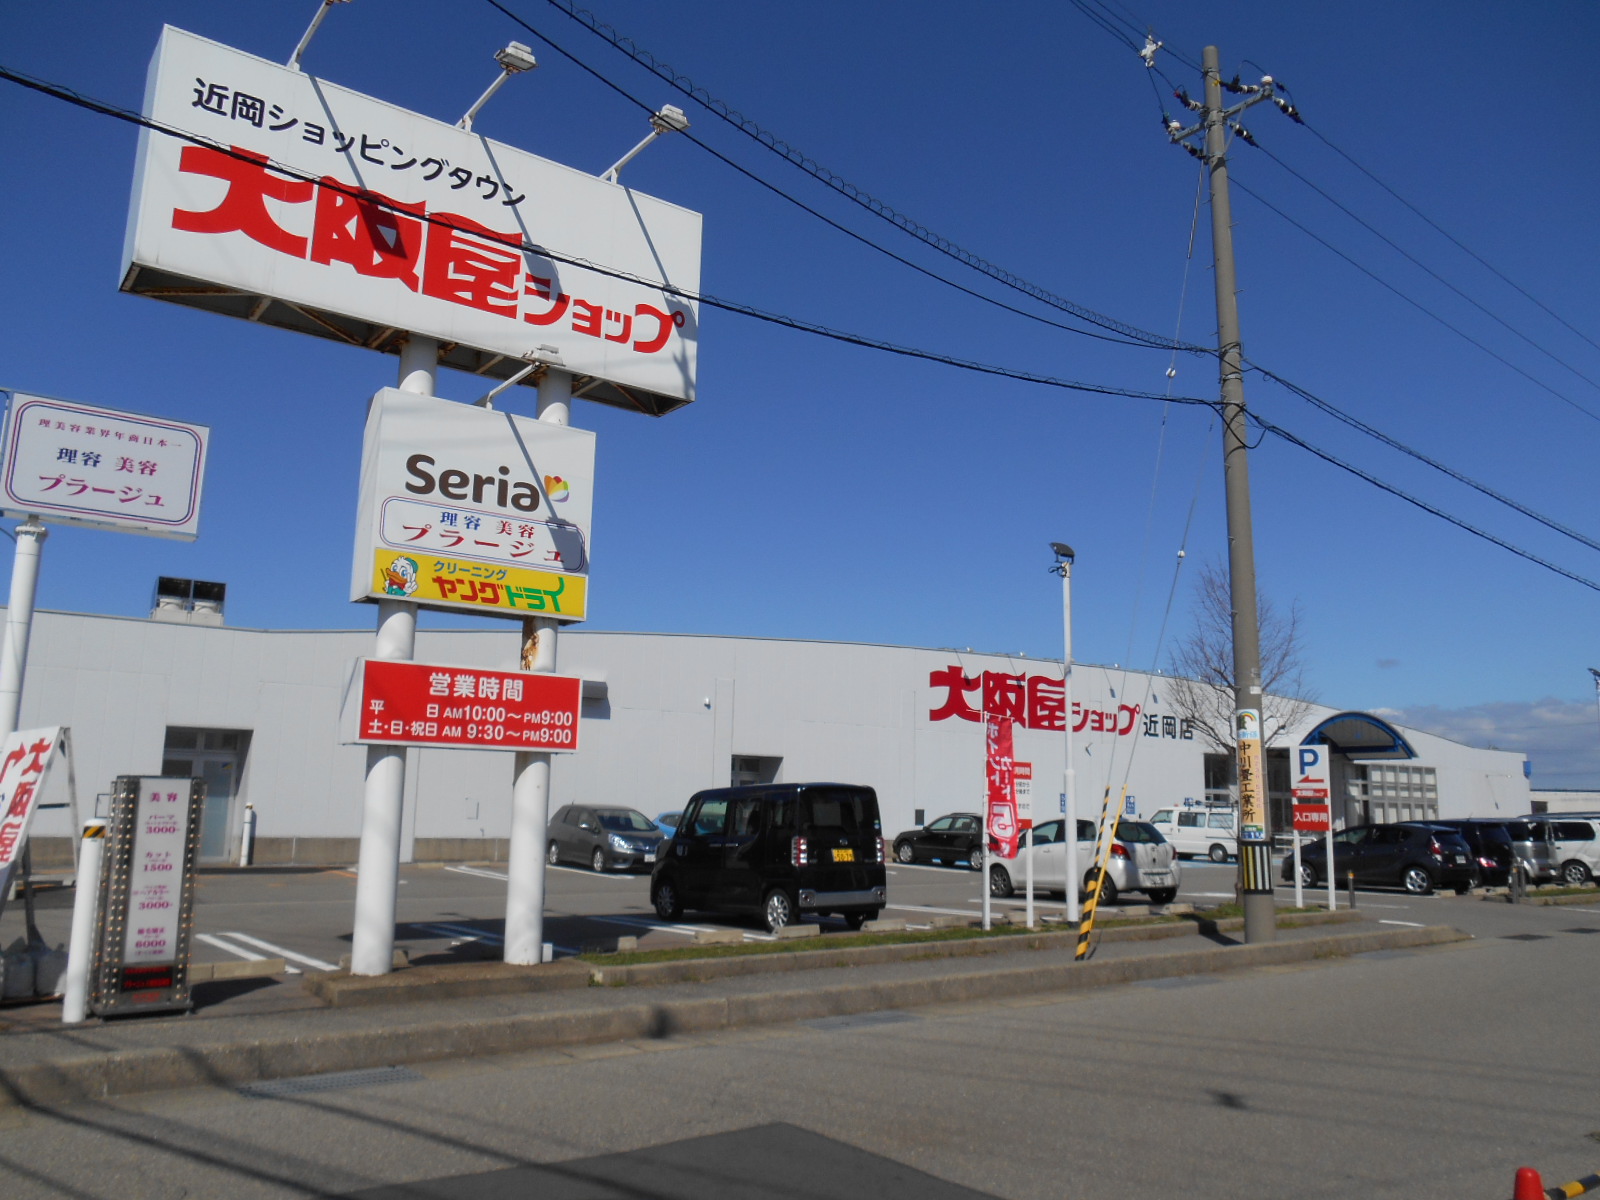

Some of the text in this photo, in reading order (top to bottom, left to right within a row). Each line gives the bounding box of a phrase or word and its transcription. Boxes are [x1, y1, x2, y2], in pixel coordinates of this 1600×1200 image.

[192, 77, 526, 206] 近岡ショッピングタウン
[171, 144, 686, 354] 大阪屋ショップ
[57, 447, 158, 476] 理容 美容
[39, 474, 164, 507] プラージュ
[405, 454, 540, 512] Seria
[440, 511, 535, 539] 理容 美容
[402, 523, 565, 563] プラージュ
[434, 560, 508, 580] クリーニング
[432, 576, 565, 612] ヤングドライ
[429, 673, 523, 701] 営業時間
[929, 665, 1195, 740] 大阪屋ショップ 近岡店
[1299, 748, 1320, 775] P
[1294, 812, 1328, 823] 入口専用
[144, 863, 173, 872] 1500
